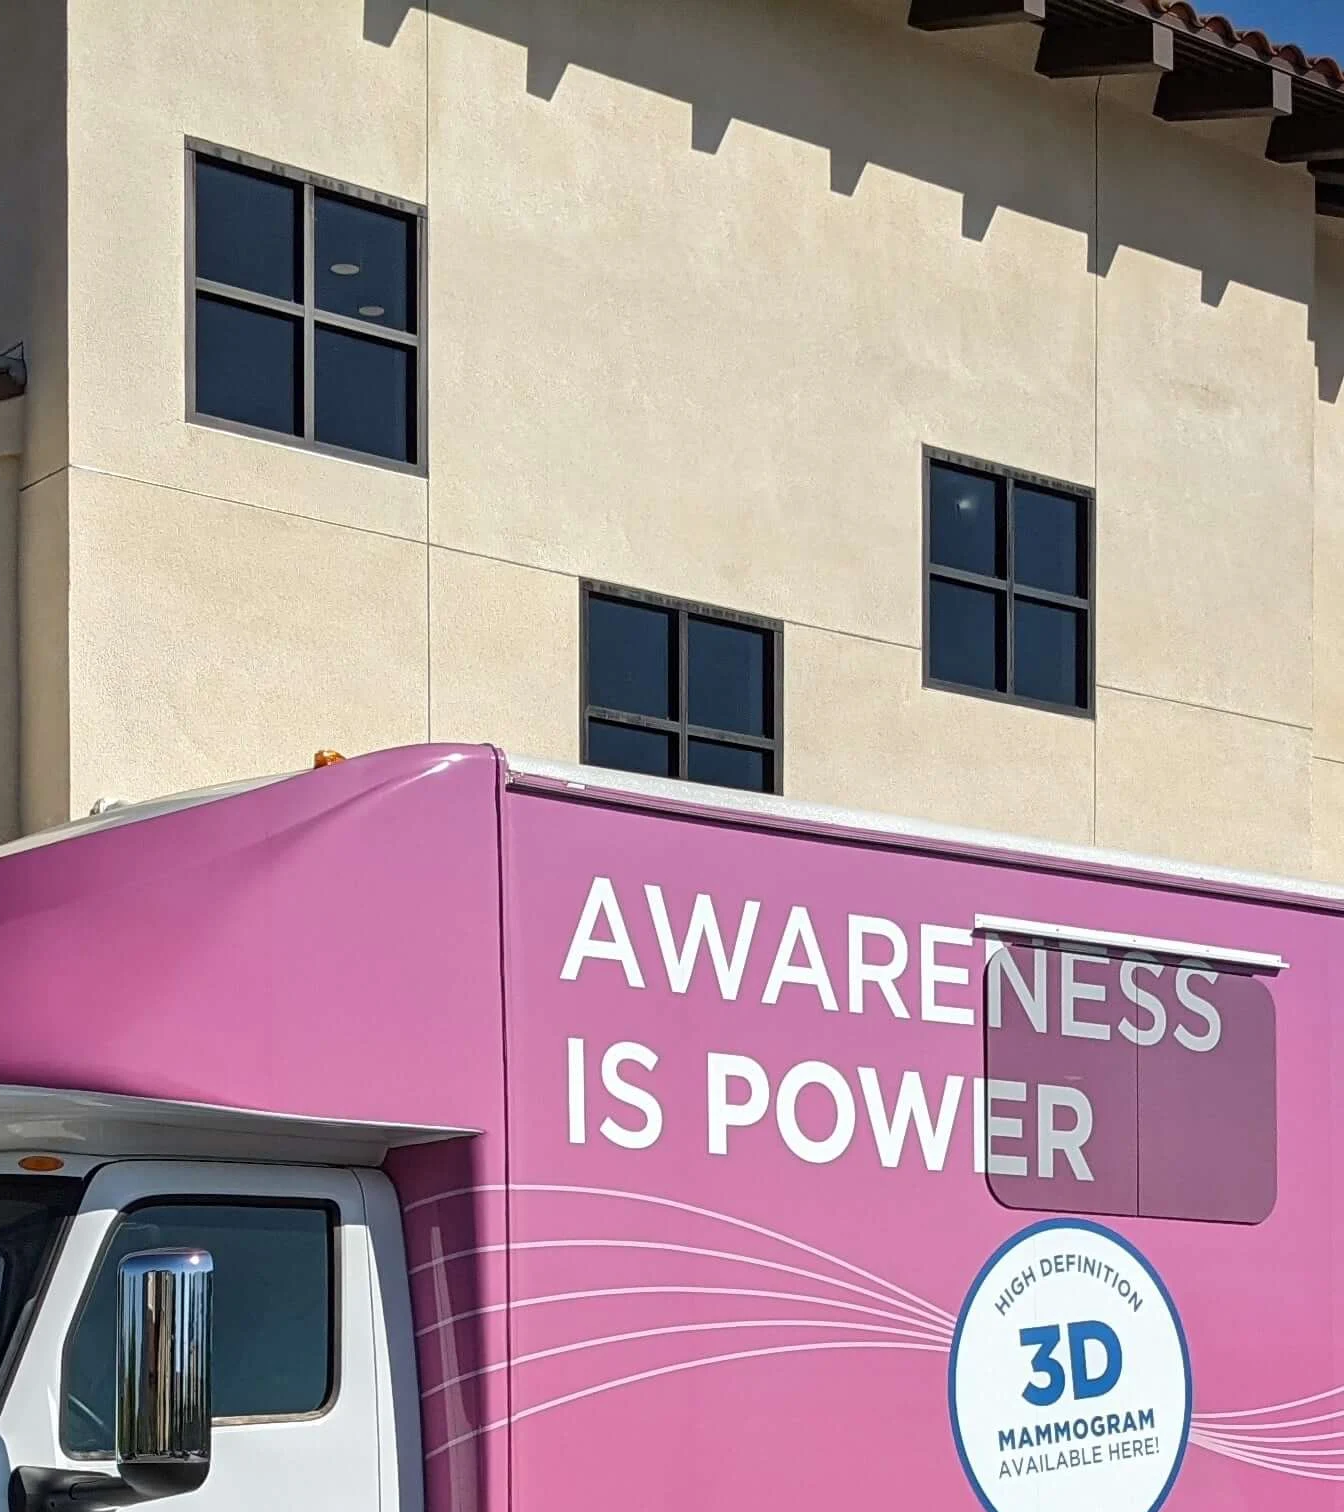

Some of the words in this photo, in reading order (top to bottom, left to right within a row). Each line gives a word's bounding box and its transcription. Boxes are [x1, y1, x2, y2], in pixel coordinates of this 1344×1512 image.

[559, 876, 1223, 1053] AWARENESS
[566, 1037, 664, 1149] IS
[707, 1051, 1095, 1181] POWER
[994, 1266, 1037, 1317] HIGH
[1040, 1254, 1144, 1313] DEFINITION
[1019, 1319, 1123, 1407] 3D
[998, 1408, 1156, 1452] MAMMOGRAM
[998, 1445, 1103, 1480] AVAILABLE
[1108, 1437, 1161, 1463] HERE!
